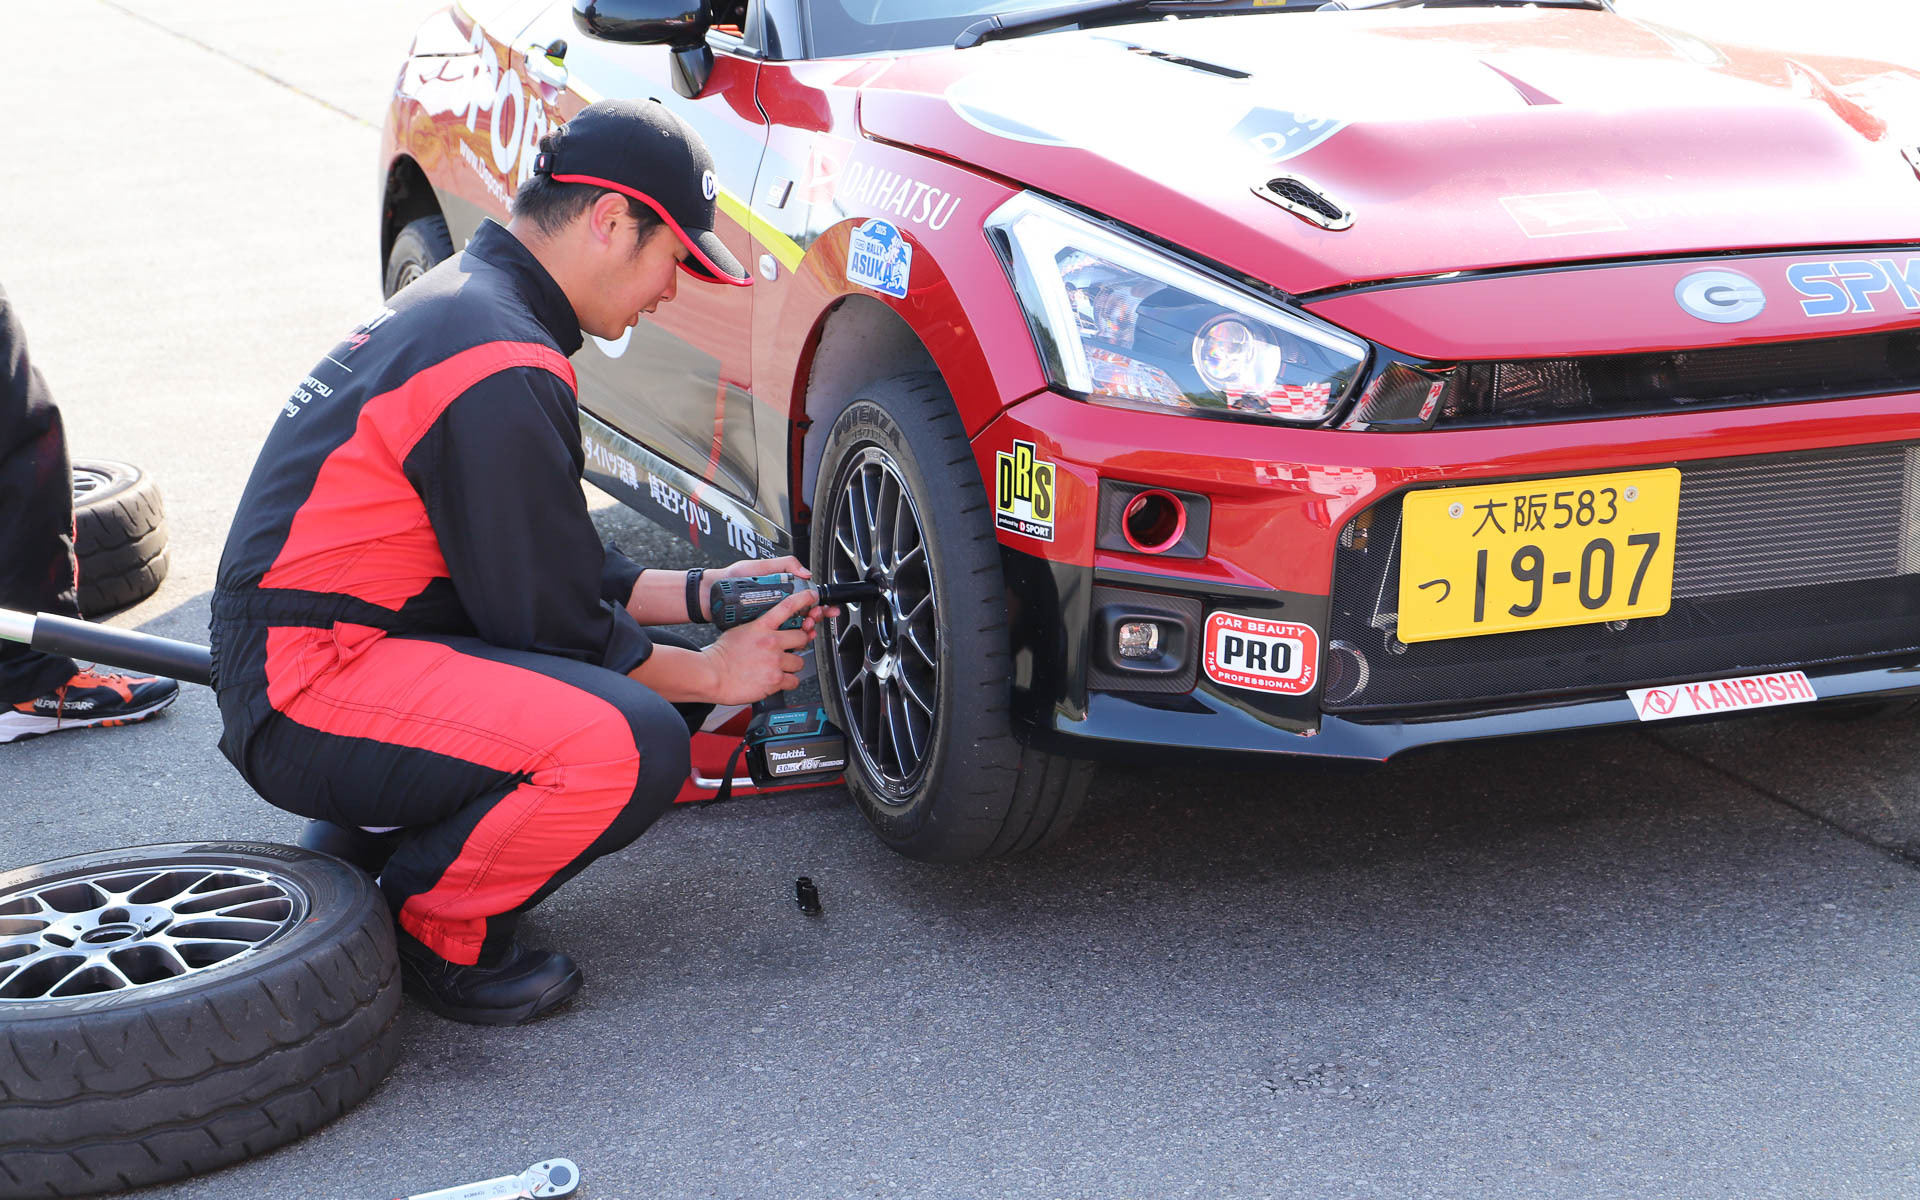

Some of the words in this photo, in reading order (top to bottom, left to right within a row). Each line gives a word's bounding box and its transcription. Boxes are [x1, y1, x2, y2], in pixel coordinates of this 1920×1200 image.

[842, 161, 961, 230] DAIHATSU
[851, 252, 893, 283] ASUKA
[866, 242, 883, 256] RALLY
[999, 445, 1052, 519] DRS
[1026, 524, 1050, 537] SPORT
[1472, 487, 1618, 537] 大阪583
[1418, 578, 1451, 604] つ
[1472, 532, 1661, 623] 19-07
[1215, 616, 1242, 629] CAR
[1247, 622, 1307, 637] BEAUTY
[1208, 650, 1217, 672] THE
[1218, 671, 1297, 690] PROFESSIONAL
[1298, 664, 1312, 686] WAY
[1223, 635, 1291, 674] PRO
[1684, 673, 1813, 711] KANBISHI
